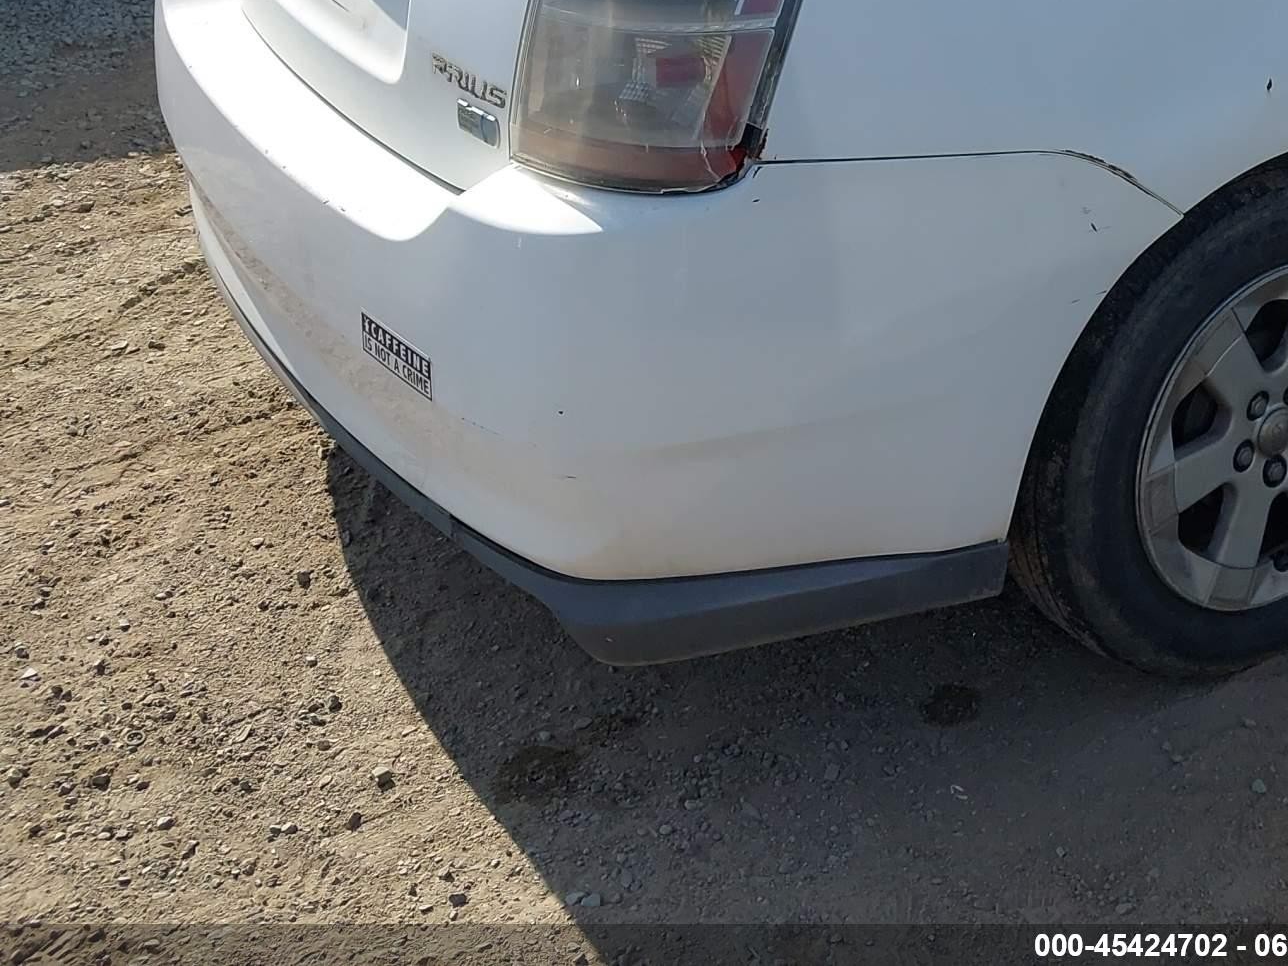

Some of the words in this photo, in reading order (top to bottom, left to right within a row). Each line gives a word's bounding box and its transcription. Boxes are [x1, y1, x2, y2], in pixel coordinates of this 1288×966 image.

[432, 52, 507, 109] PRIUS
[364, 333, 373, 352] IS
[374, 341, 391, 366] NOT
[393, 357, 400, 374] A
[402, 363, 430, 395] CRIME
